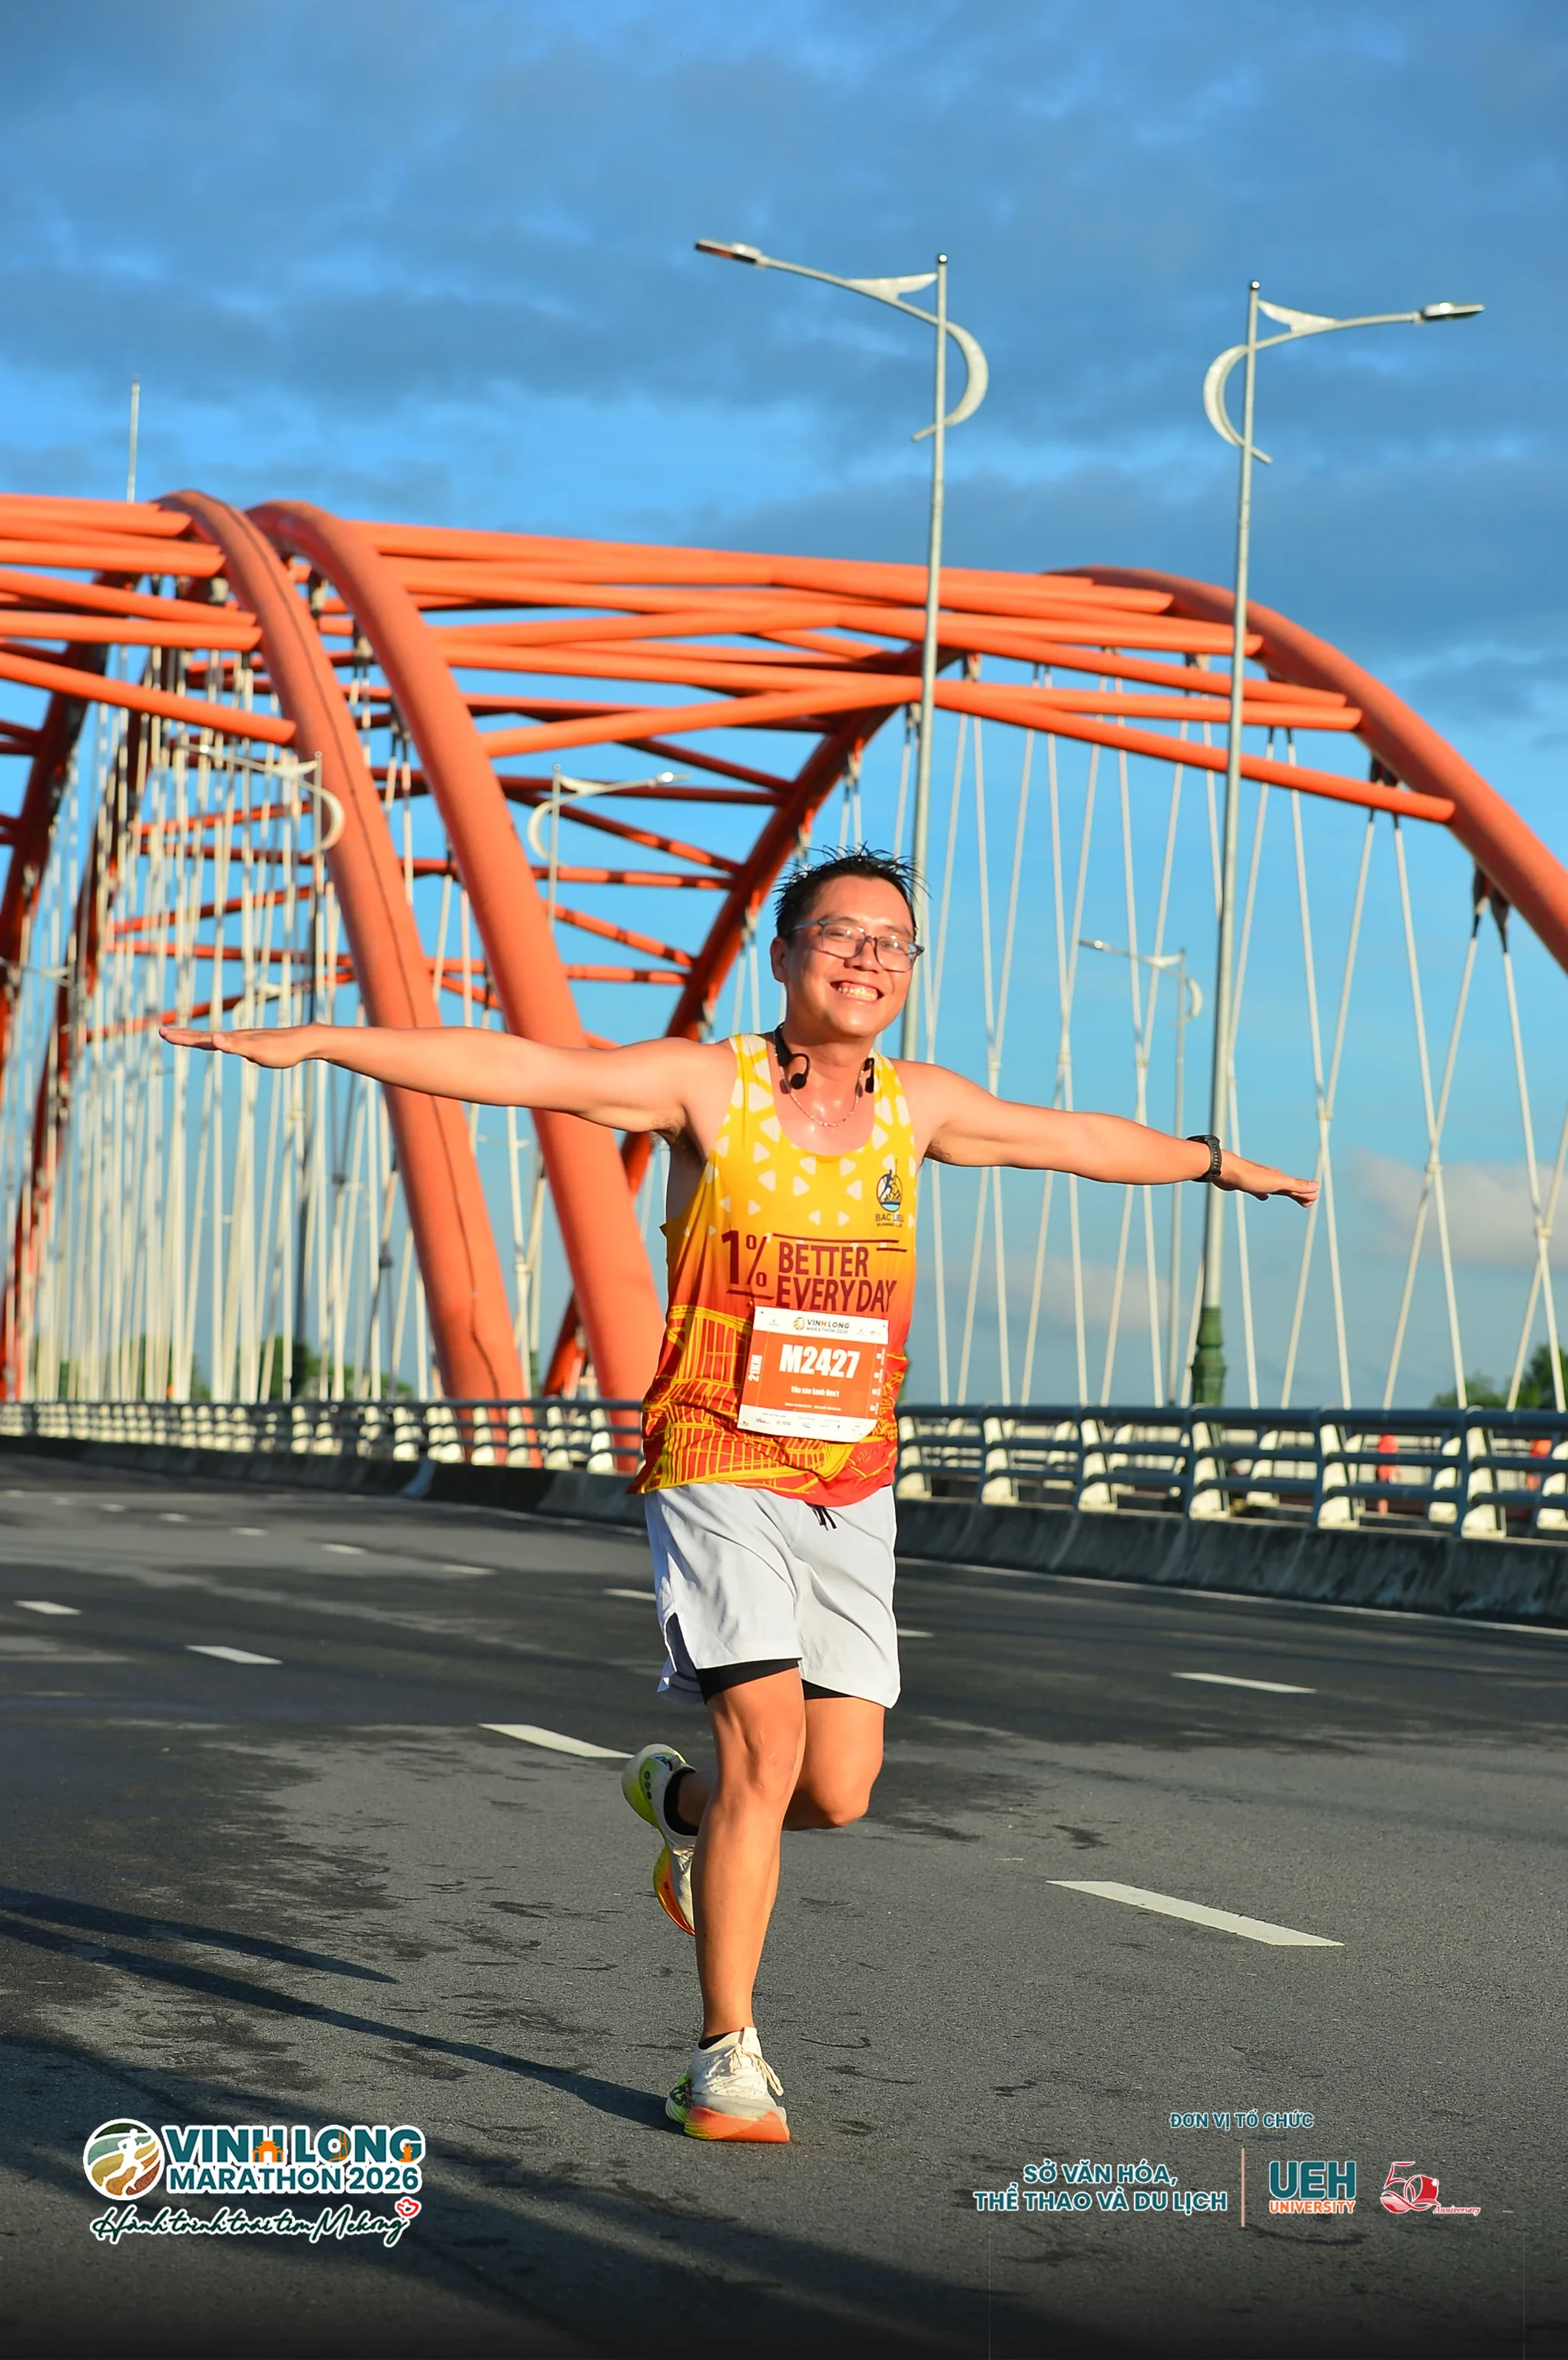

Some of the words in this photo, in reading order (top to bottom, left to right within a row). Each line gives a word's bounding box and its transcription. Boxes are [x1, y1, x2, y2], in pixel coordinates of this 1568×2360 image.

[721, 1229, 768, 1288] 1%
[778, 1241, 870, 1278] BETTER
[776, 1275, 897, 1313] EVERYDAY
[807, 1319, 827, 1328] VINH
[828, 1321, 850, 1330] LONG
[748, 1354, 763, 1383] 21KM
[779, 1344, 861, 1379] M2427
